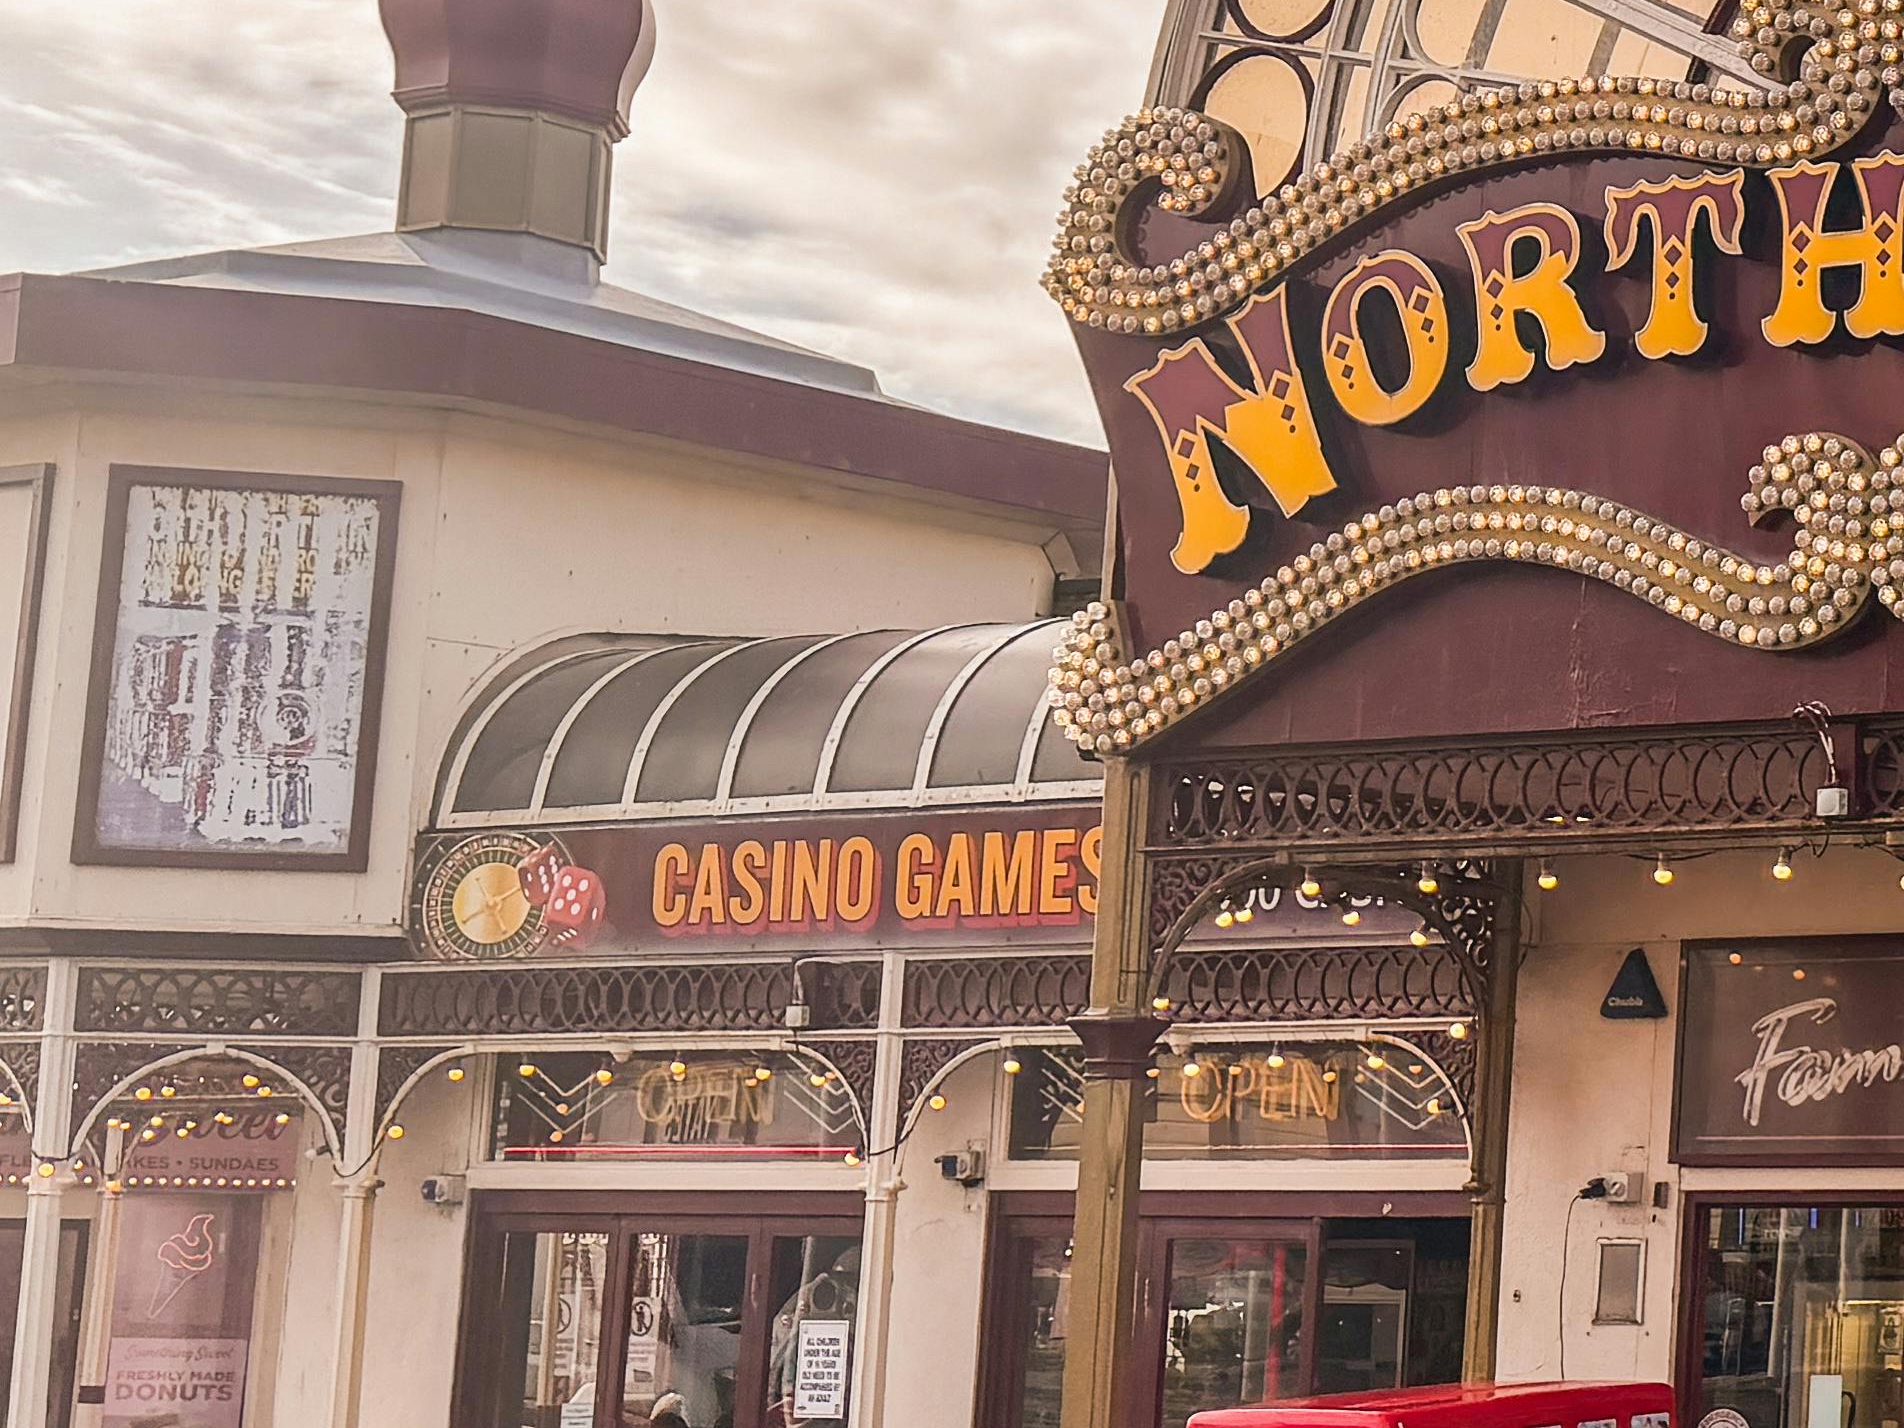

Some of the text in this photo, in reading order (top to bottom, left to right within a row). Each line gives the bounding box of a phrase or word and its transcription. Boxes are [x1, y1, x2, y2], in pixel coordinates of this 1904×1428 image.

[652, 826, 1102, 929] CASINO GAMES
[1608, 996, 1643, 1006] Chubb
[637, 1067, 775, 1125] OPEN
[1182, 1058, 1340, 1121] OPEN
[190, 1157, 279, 1171] SUNDAES
[116, 1371, 235, 1382] FRESHLY MADE
[115, 1383, 233, 1401] DONUTS
